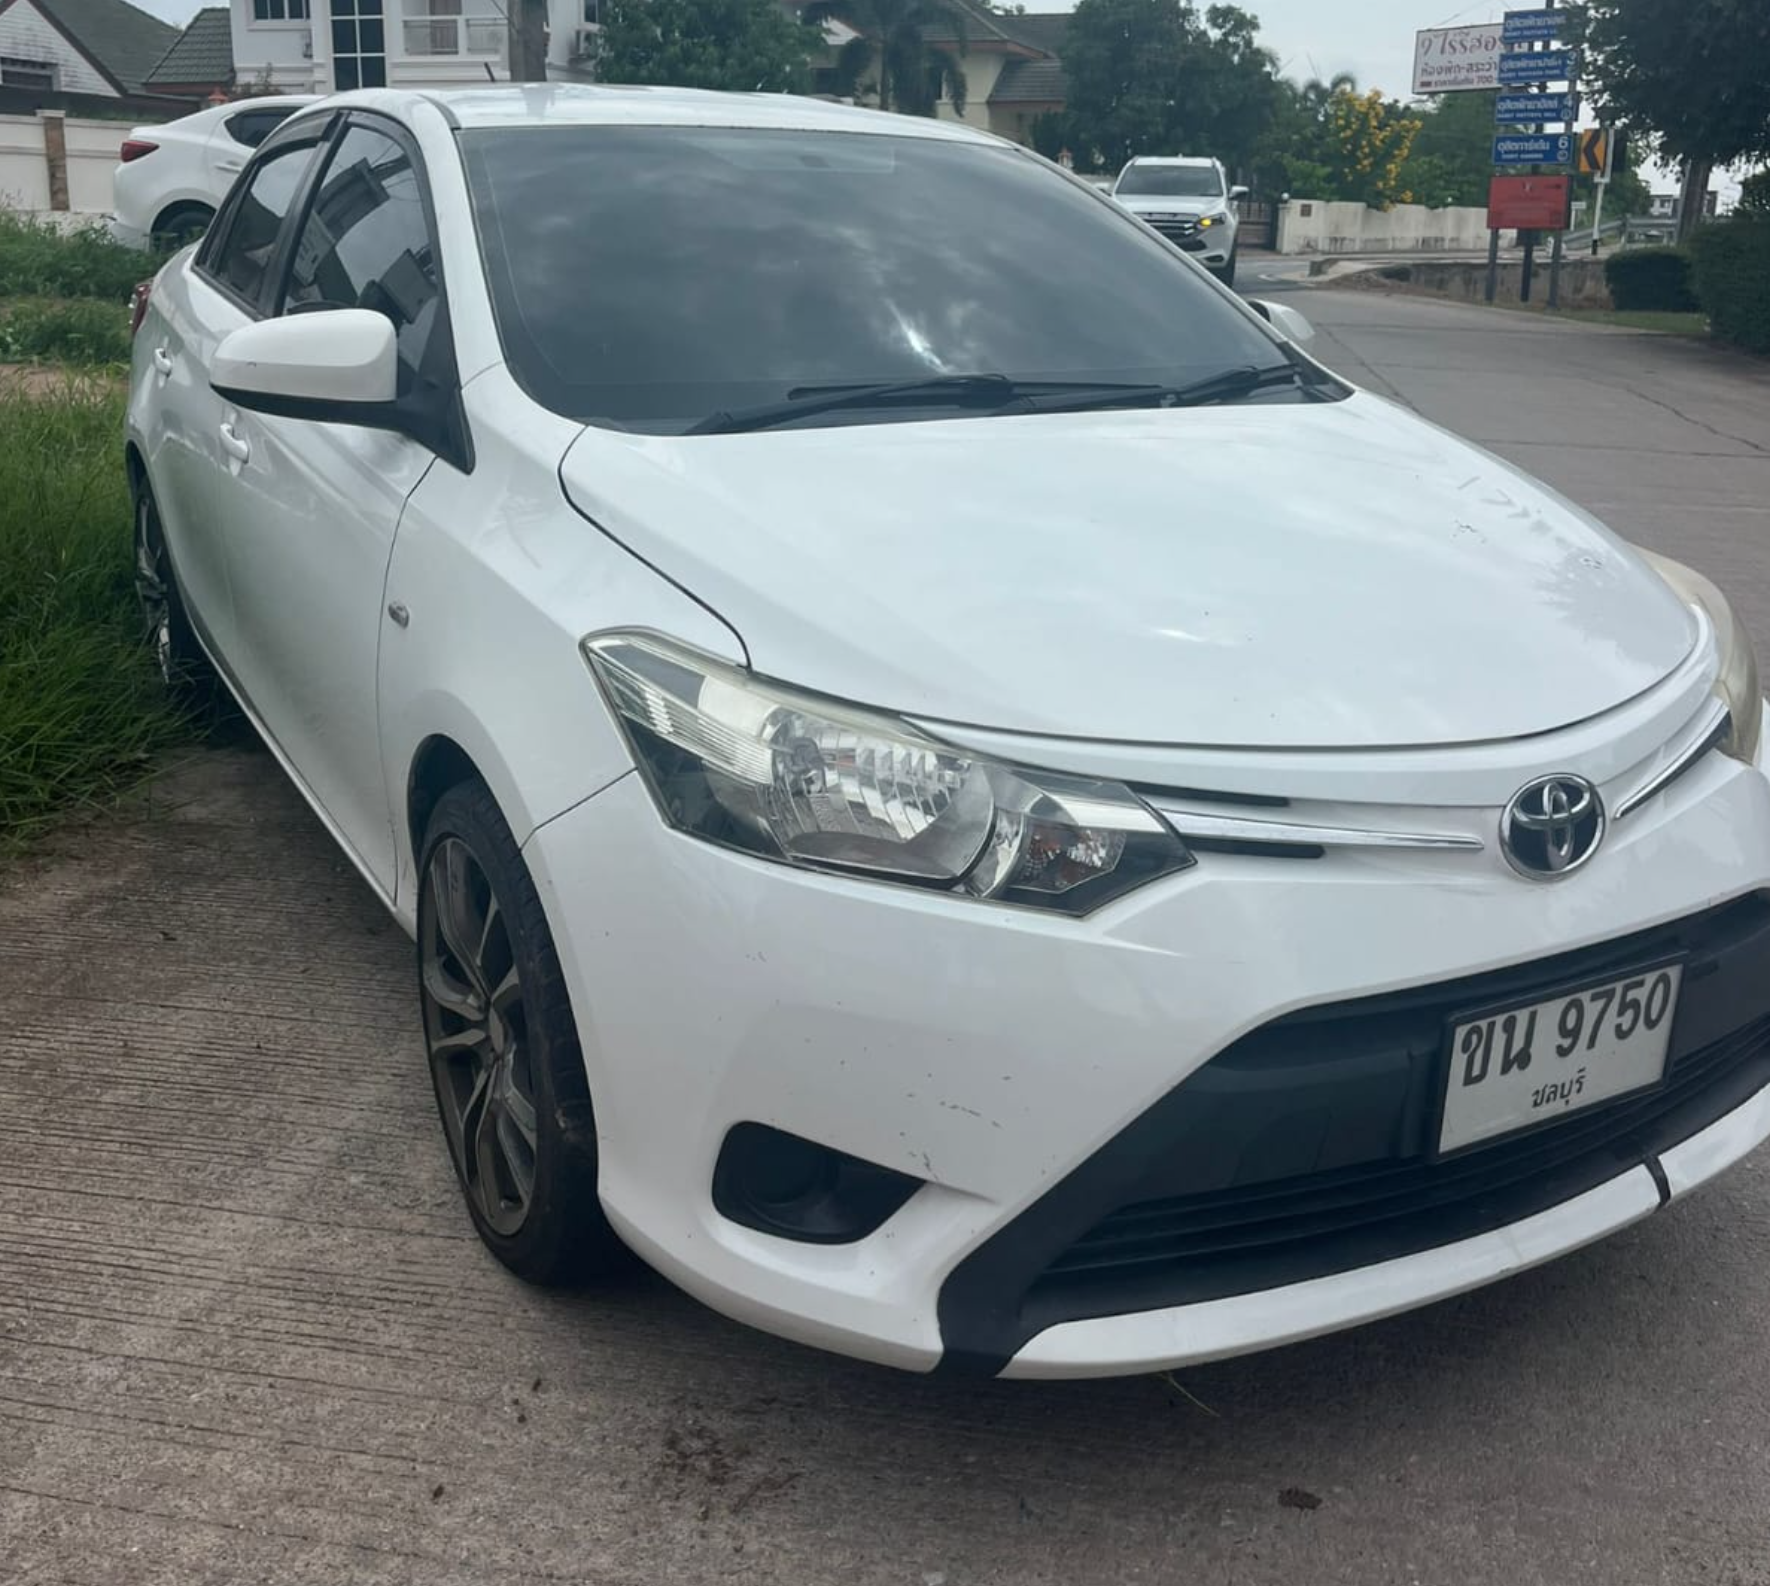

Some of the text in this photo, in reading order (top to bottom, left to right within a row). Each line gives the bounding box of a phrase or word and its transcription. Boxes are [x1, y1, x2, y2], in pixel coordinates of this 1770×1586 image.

[1563, 93, 1573, 107] 4
[1558, 135, 1569, 150] 6
[1461, 972, 1671, 1087] ขน 9750
[1531, 1067, 1586, 1108] ชลบุรี
